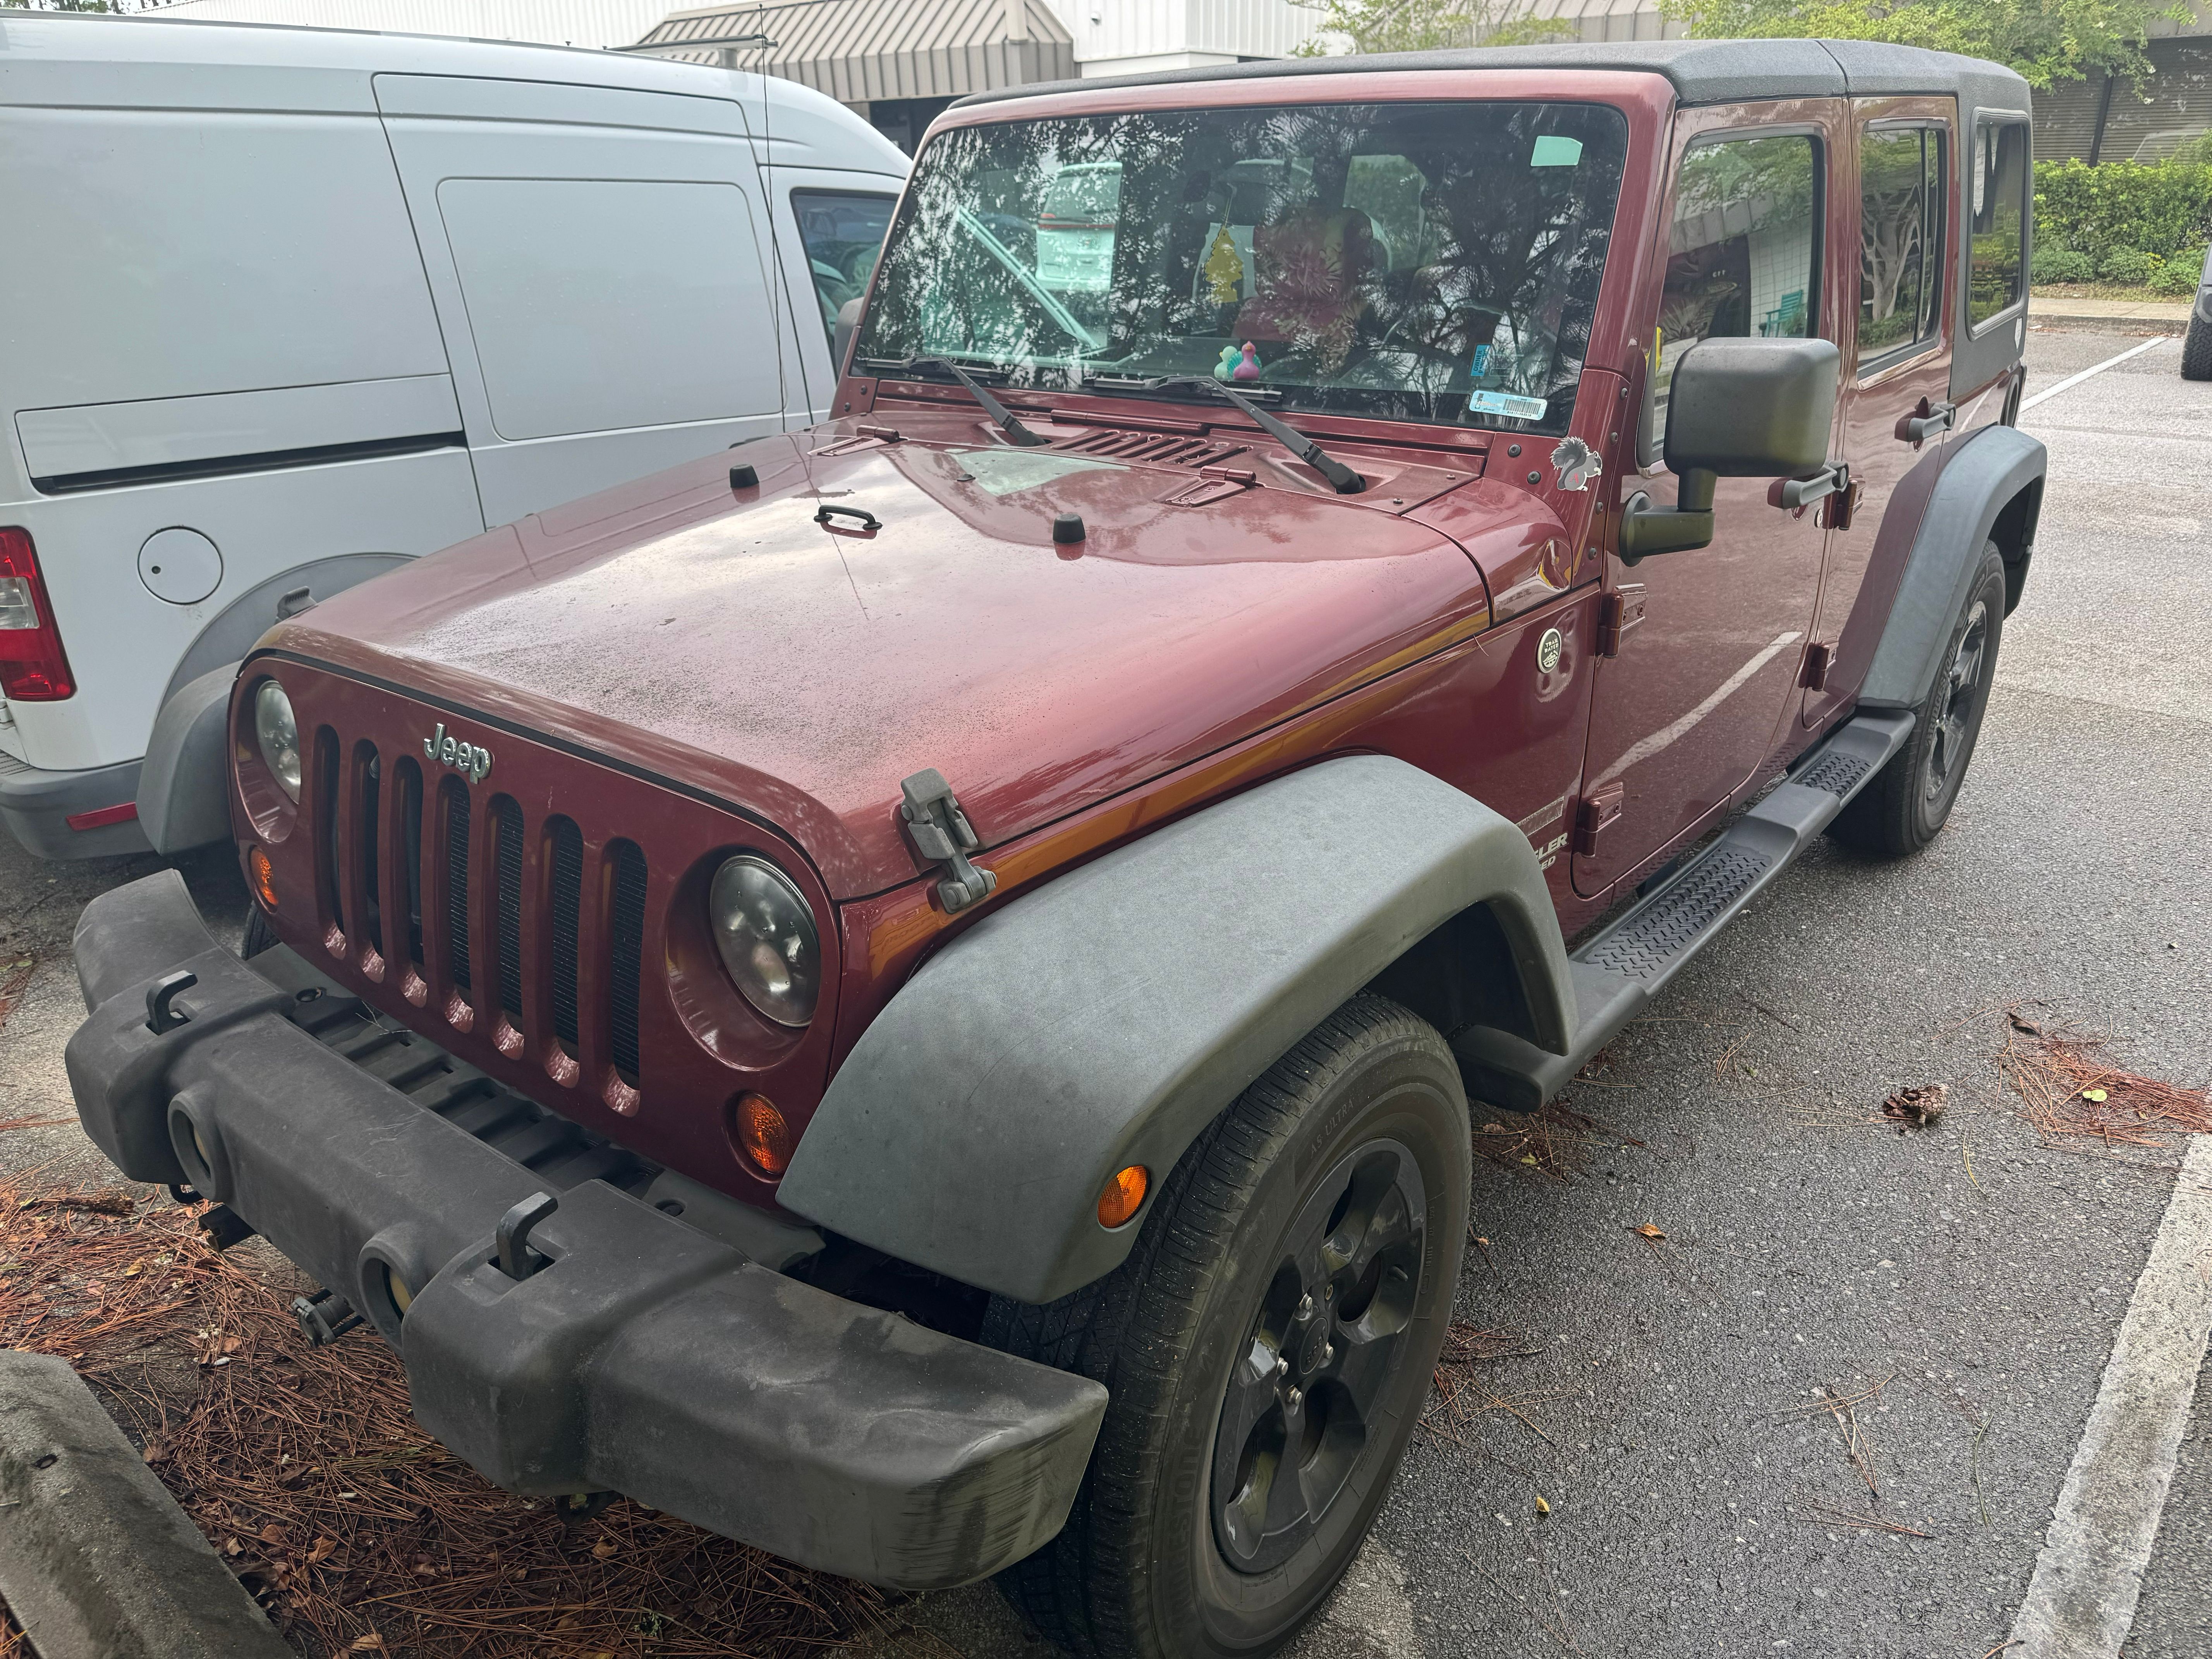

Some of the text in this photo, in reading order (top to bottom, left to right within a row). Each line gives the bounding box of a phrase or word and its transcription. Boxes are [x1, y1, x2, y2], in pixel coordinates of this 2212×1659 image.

[1473, 350, 1483, 371] OWNER
[1544, 643, 1559, 653] RATED
[1545, 638, 1558, 647] TRAIL
[424, 723, 491, 785] Jeep
[1540, 855, 1556, 870] ED
[1311, 1098, 1353, 1159] AS ULTRA
